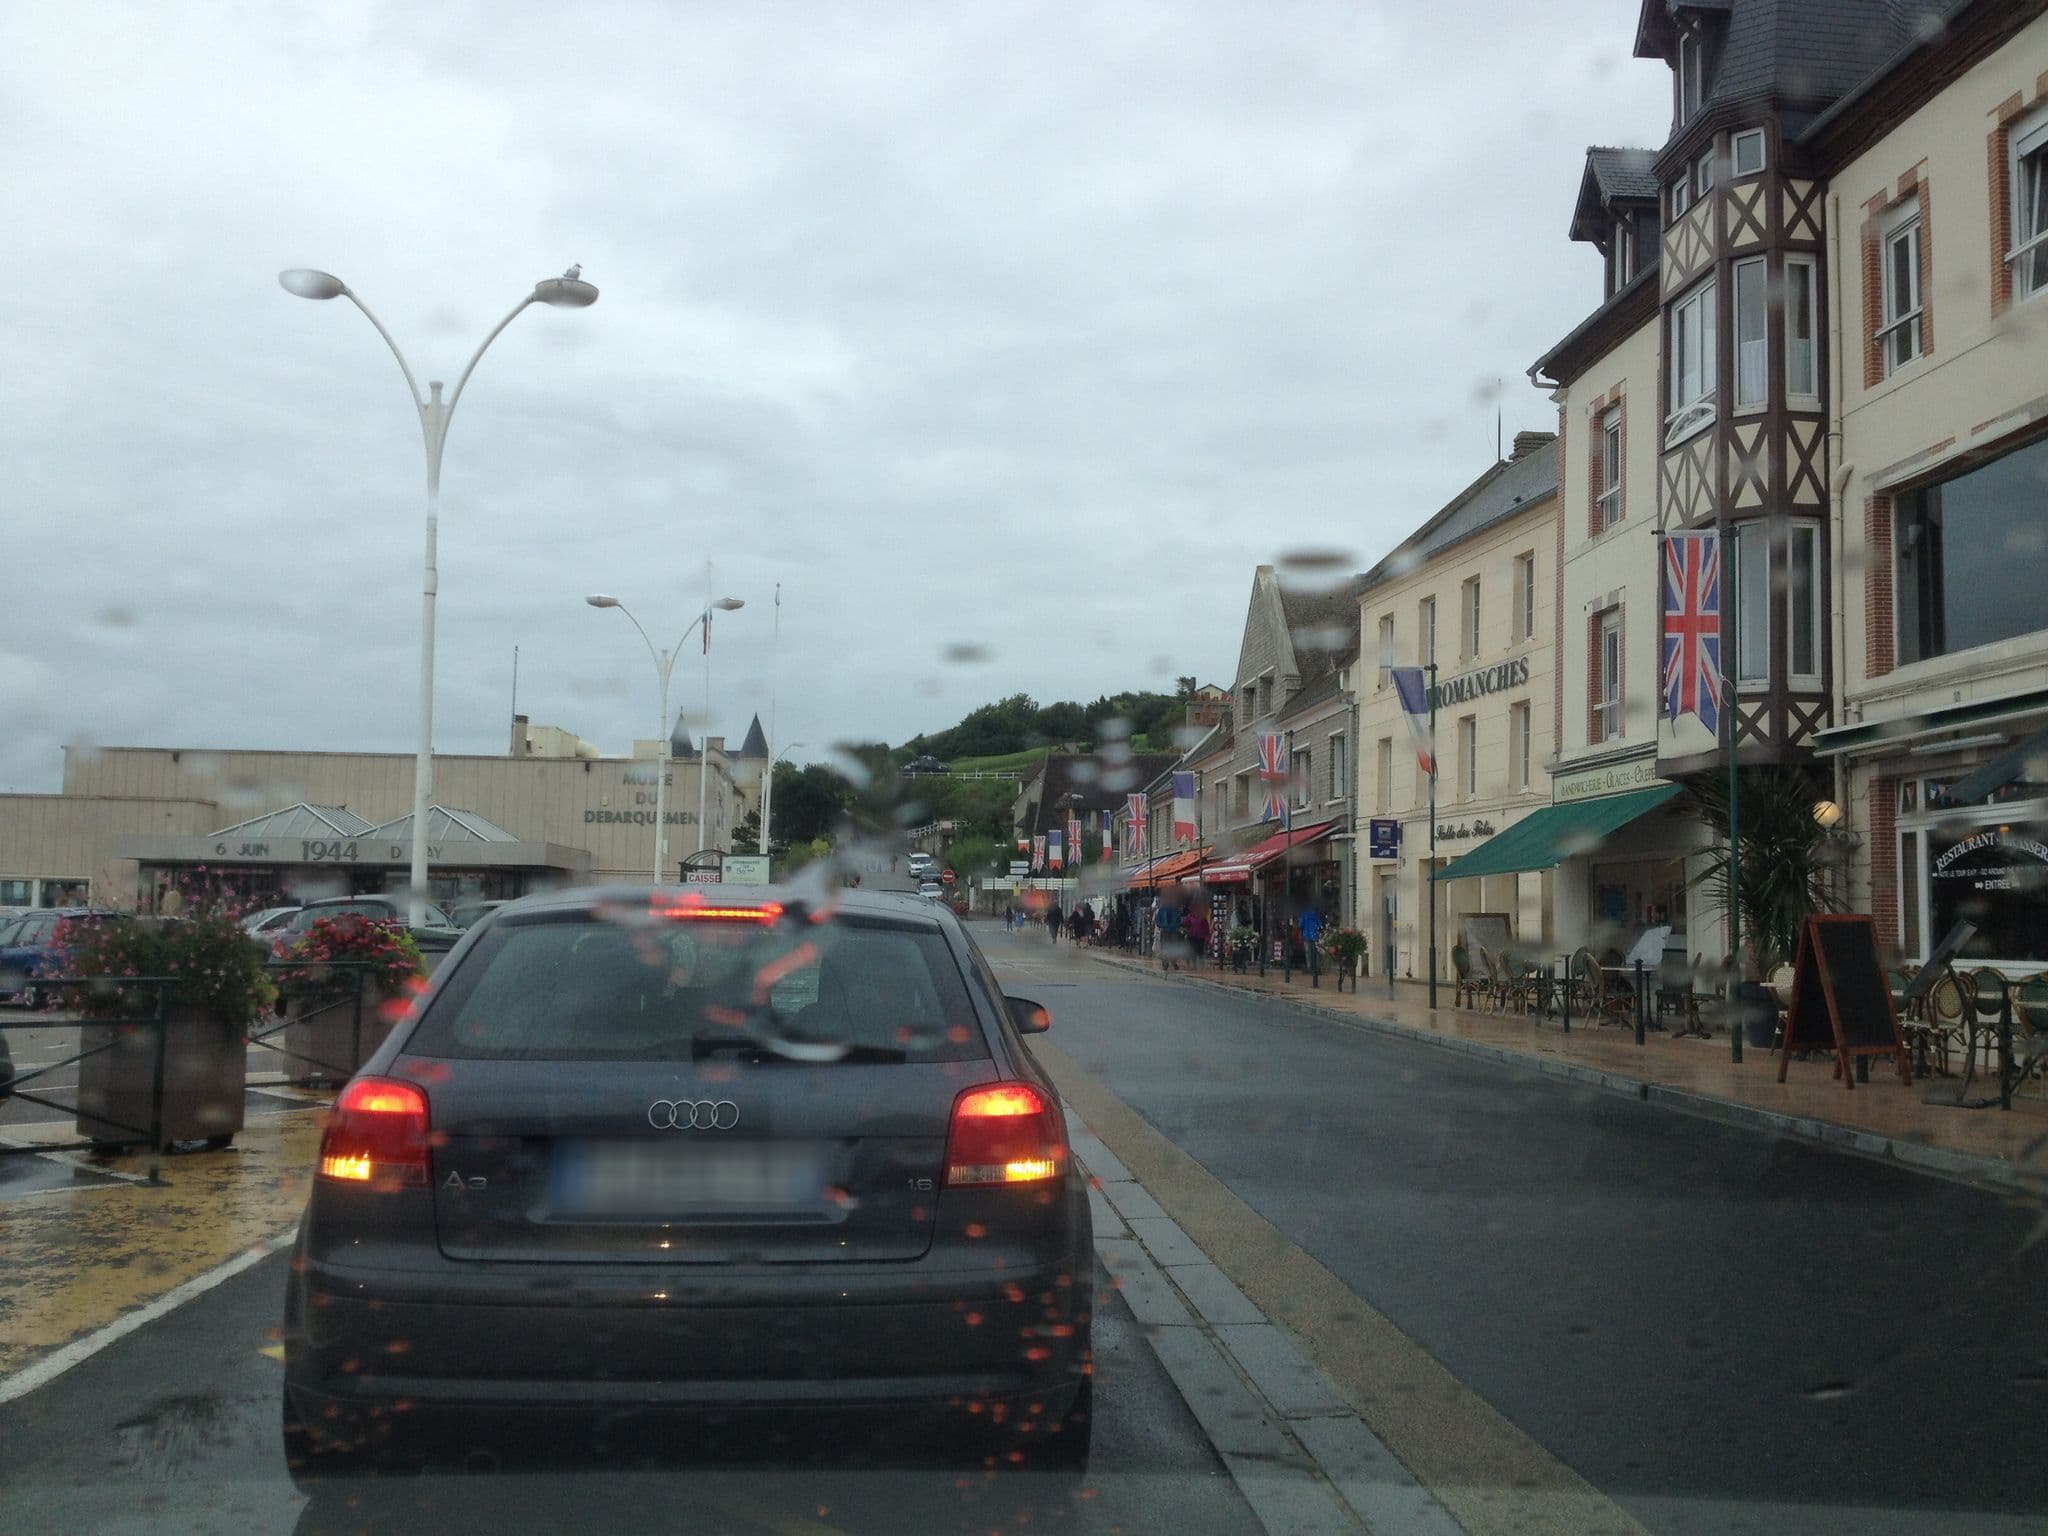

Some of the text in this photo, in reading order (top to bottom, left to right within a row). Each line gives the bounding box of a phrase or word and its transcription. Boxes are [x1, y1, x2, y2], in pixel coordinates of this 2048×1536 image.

[583, 810, 702, 826] DEBARQUEMEN
[215, 842, 227, 856] 6
[236, 843, 271, 857] JUIN
[302, 840, 358, 861] 1944
[391, 846, 402, 859] D
[1936, 832, 1997, 870] RESTAURANT
[688, 873, 721, 883] CAISSE
[441, 1170, 488, 1191] A3
